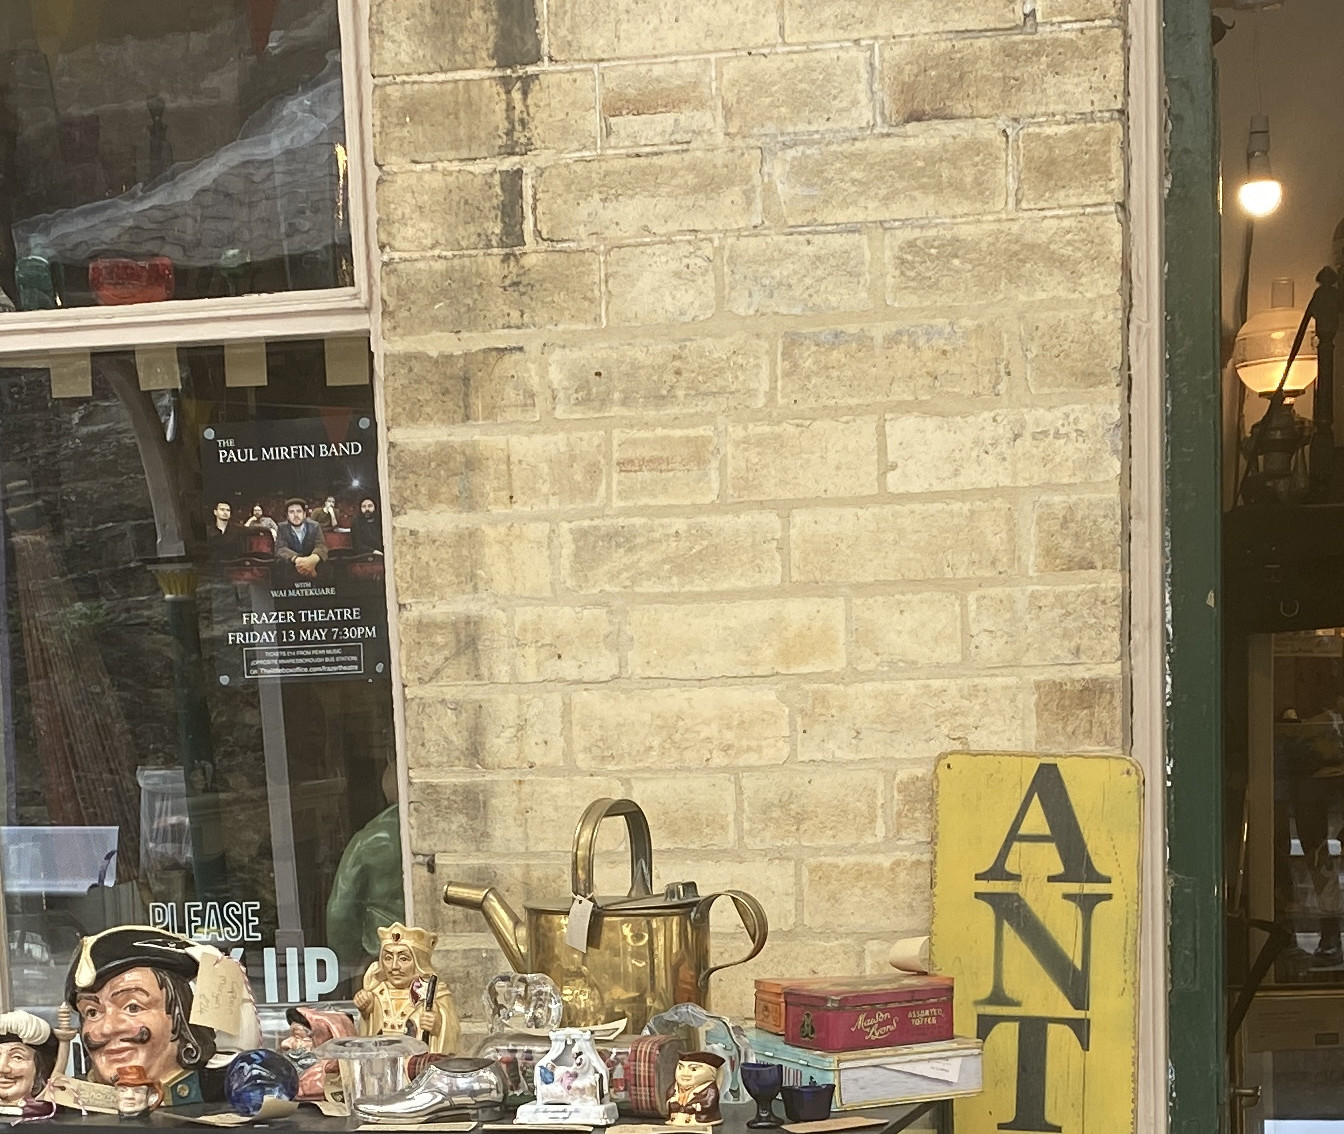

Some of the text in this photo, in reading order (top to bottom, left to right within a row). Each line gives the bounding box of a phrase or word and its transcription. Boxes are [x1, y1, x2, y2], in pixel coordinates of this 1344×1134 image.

[217, 438, 235, 448] THE
[219, 441, 363, 463] PAUL MIRFIN BAND
[270, 589, 287, 598] WAI
[242, 607, 361, 625] FRAZER THEATRE
[227, 625, 377, 645] FRIDAY 13 MAY 7:30PM
[149, 901, 262, 941] PLEASE
